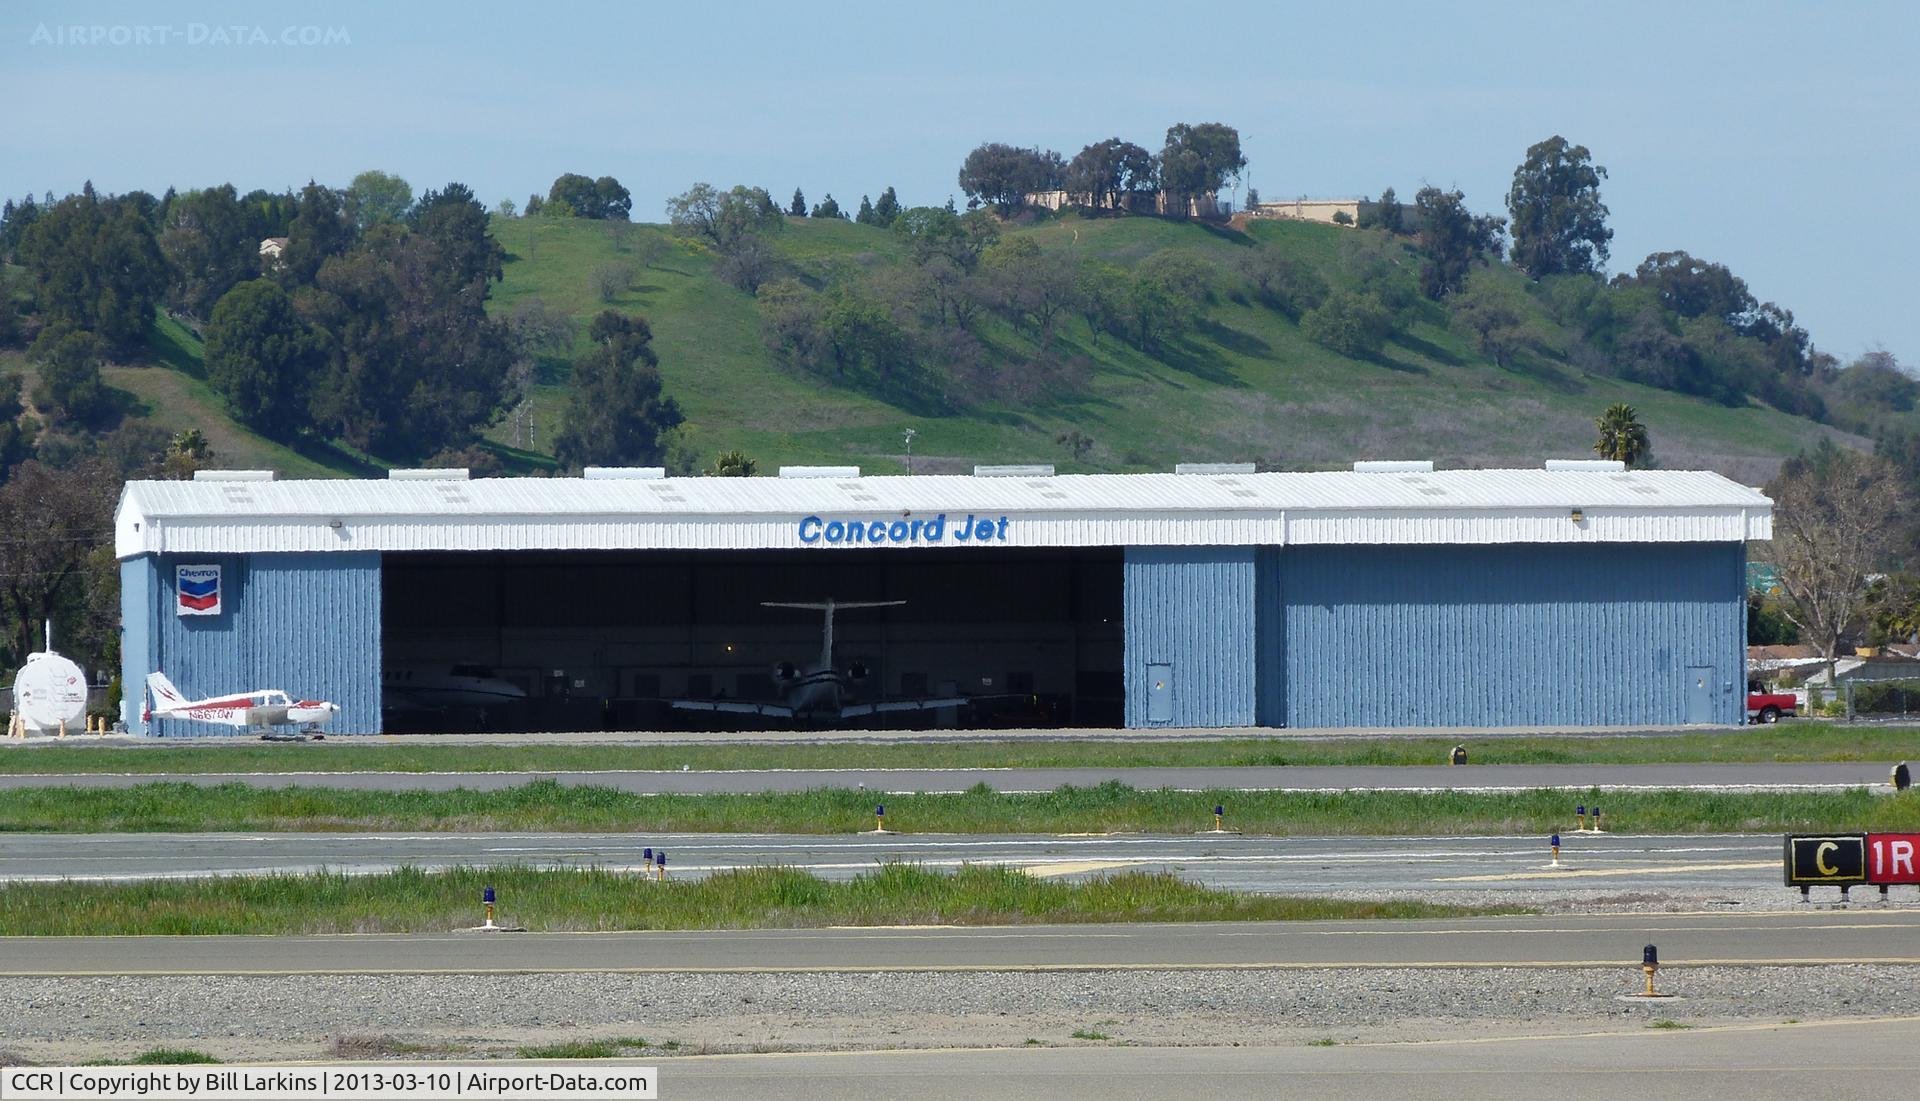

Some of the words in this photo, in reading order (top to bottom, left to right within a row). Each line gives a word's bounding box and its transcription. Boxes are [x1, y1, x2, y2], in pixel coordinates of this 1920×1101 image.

[799, 514, 945, 543] Concord
[955, 514, 1009, 541] Jet
[180, 568, 218, 577] Chevron
[1816, 841, 1839, 875] C
[1873, 841, 1914, 875] 1R
